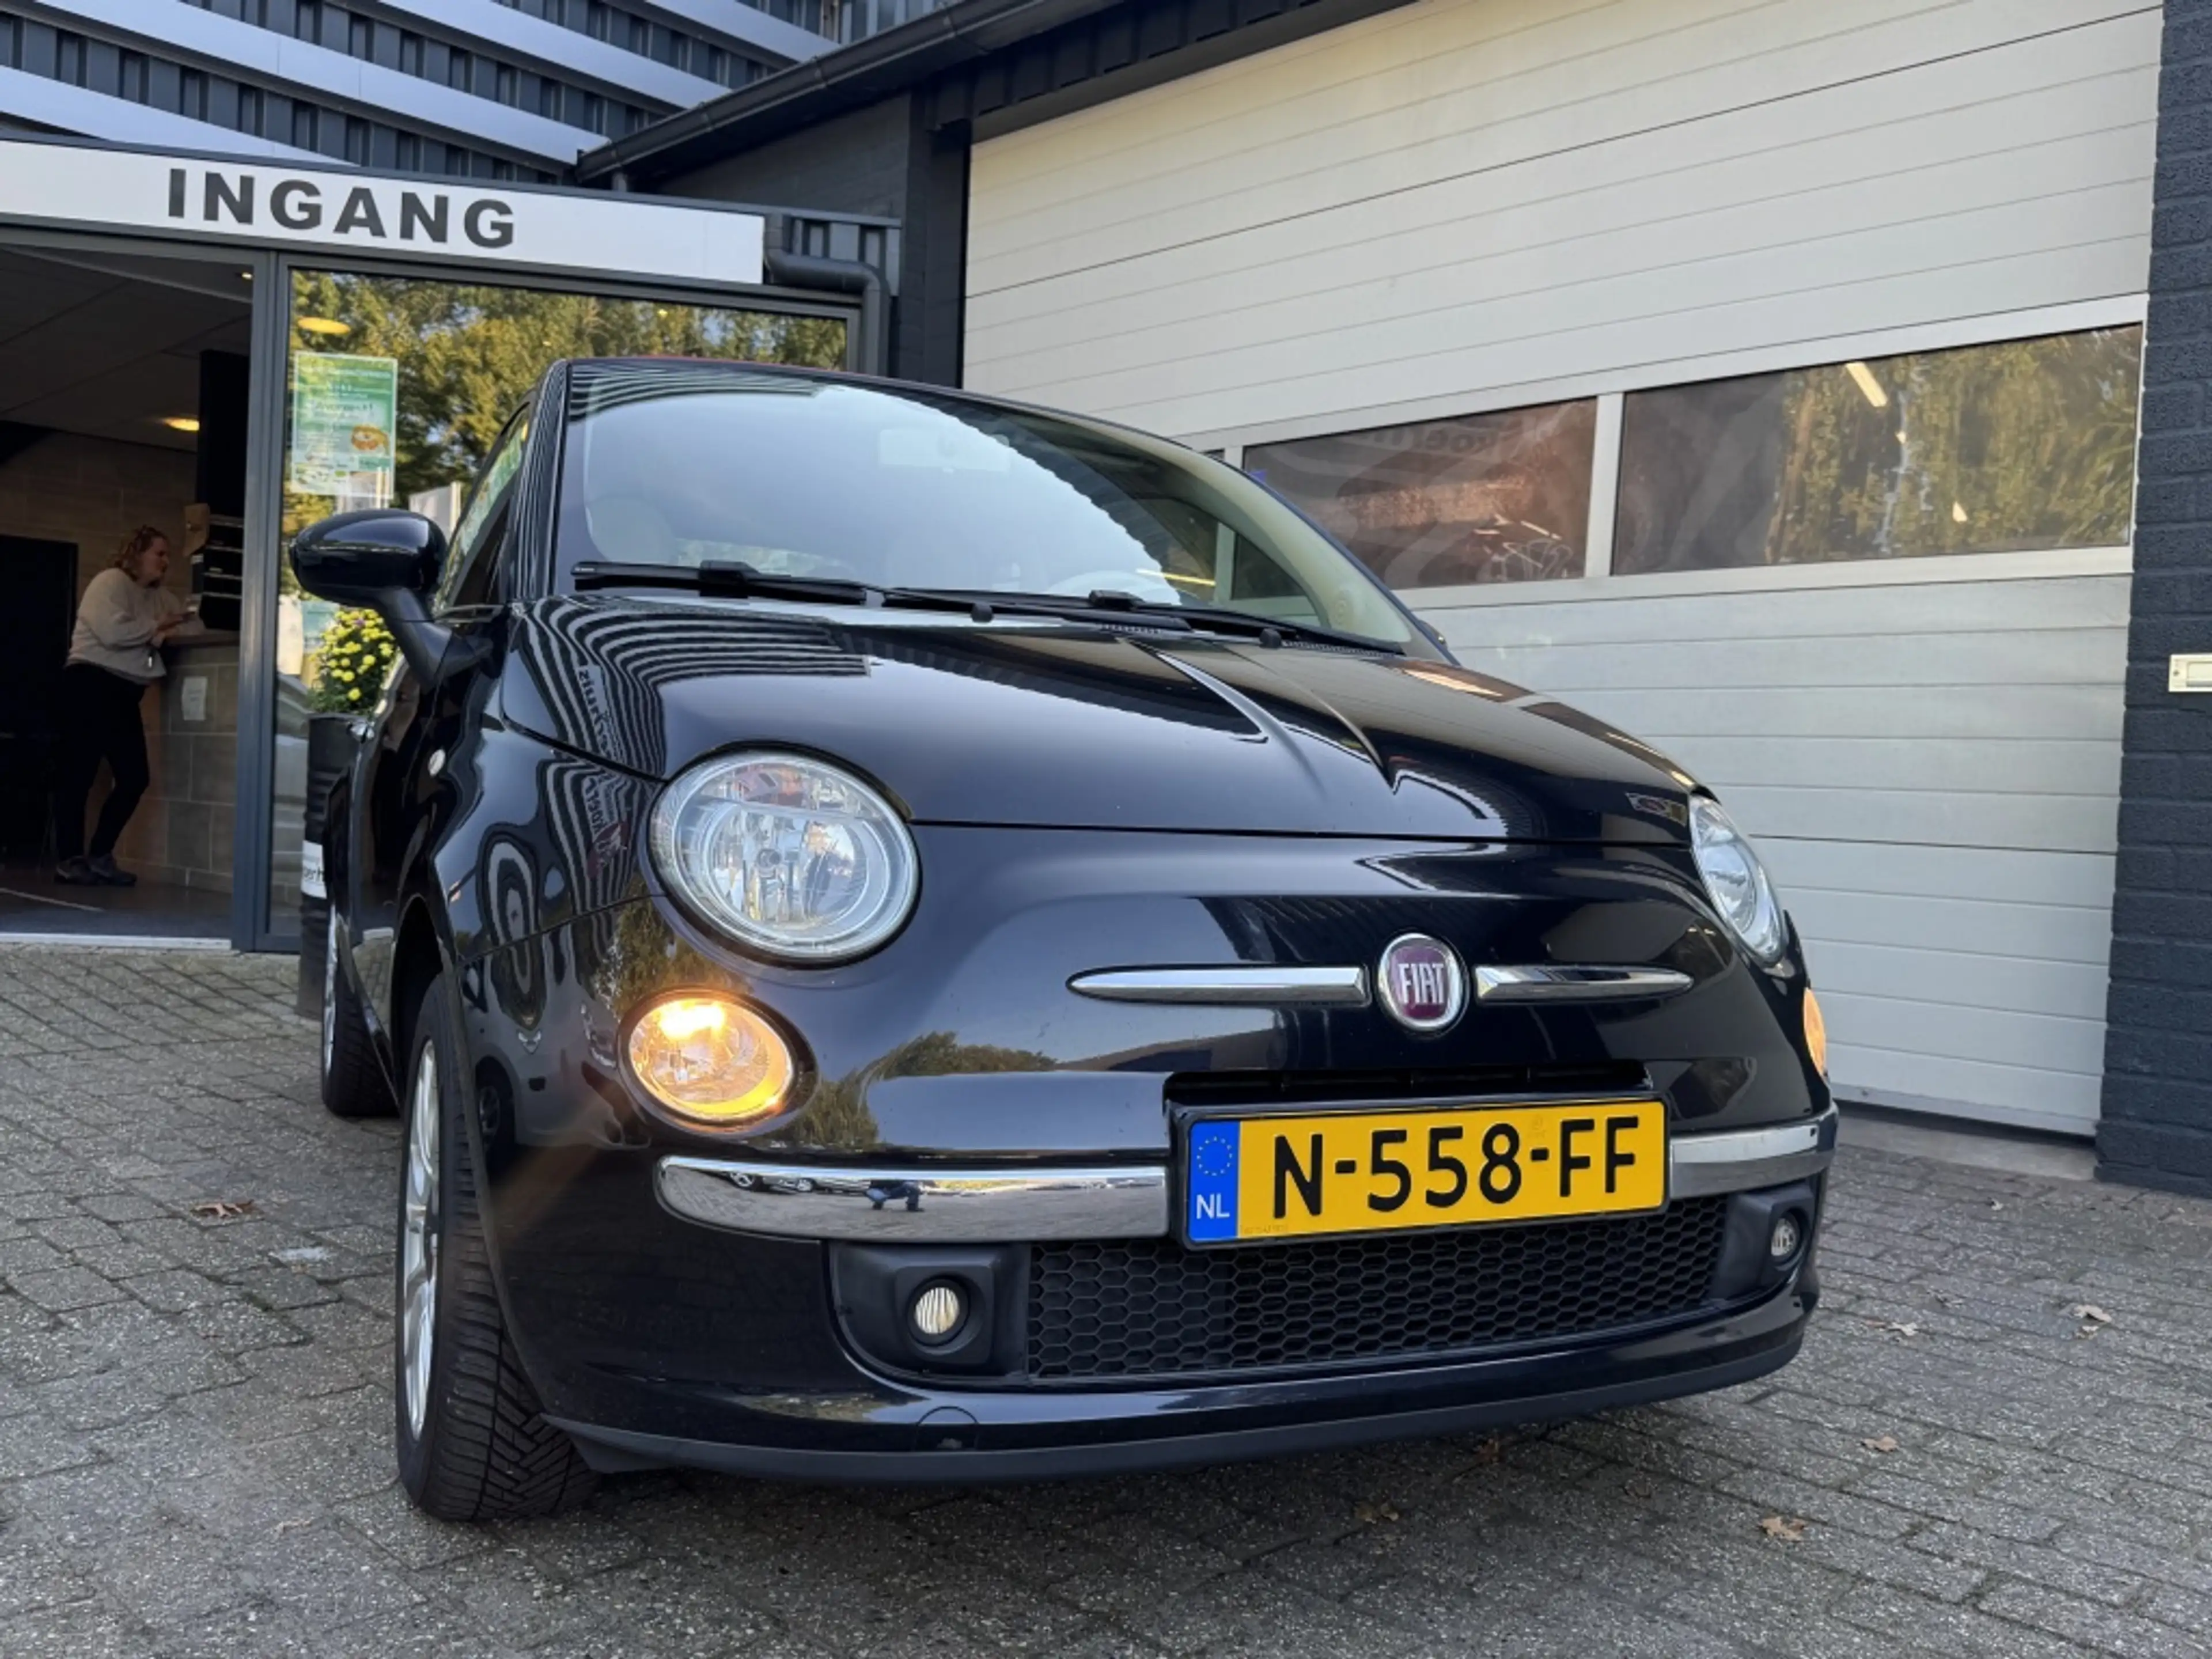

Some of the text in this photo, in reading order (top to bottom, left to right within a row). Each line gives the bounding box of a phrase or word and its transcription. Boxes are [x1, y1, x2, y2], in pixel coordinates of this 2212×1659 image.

[168, 168, 514, 249] INGANG
[1399, 963, 1444, 1003] FIAT
[1273, 1116, 1640, 1219] N-558-FF
[1196, 1193, 1230, 1219] NL
